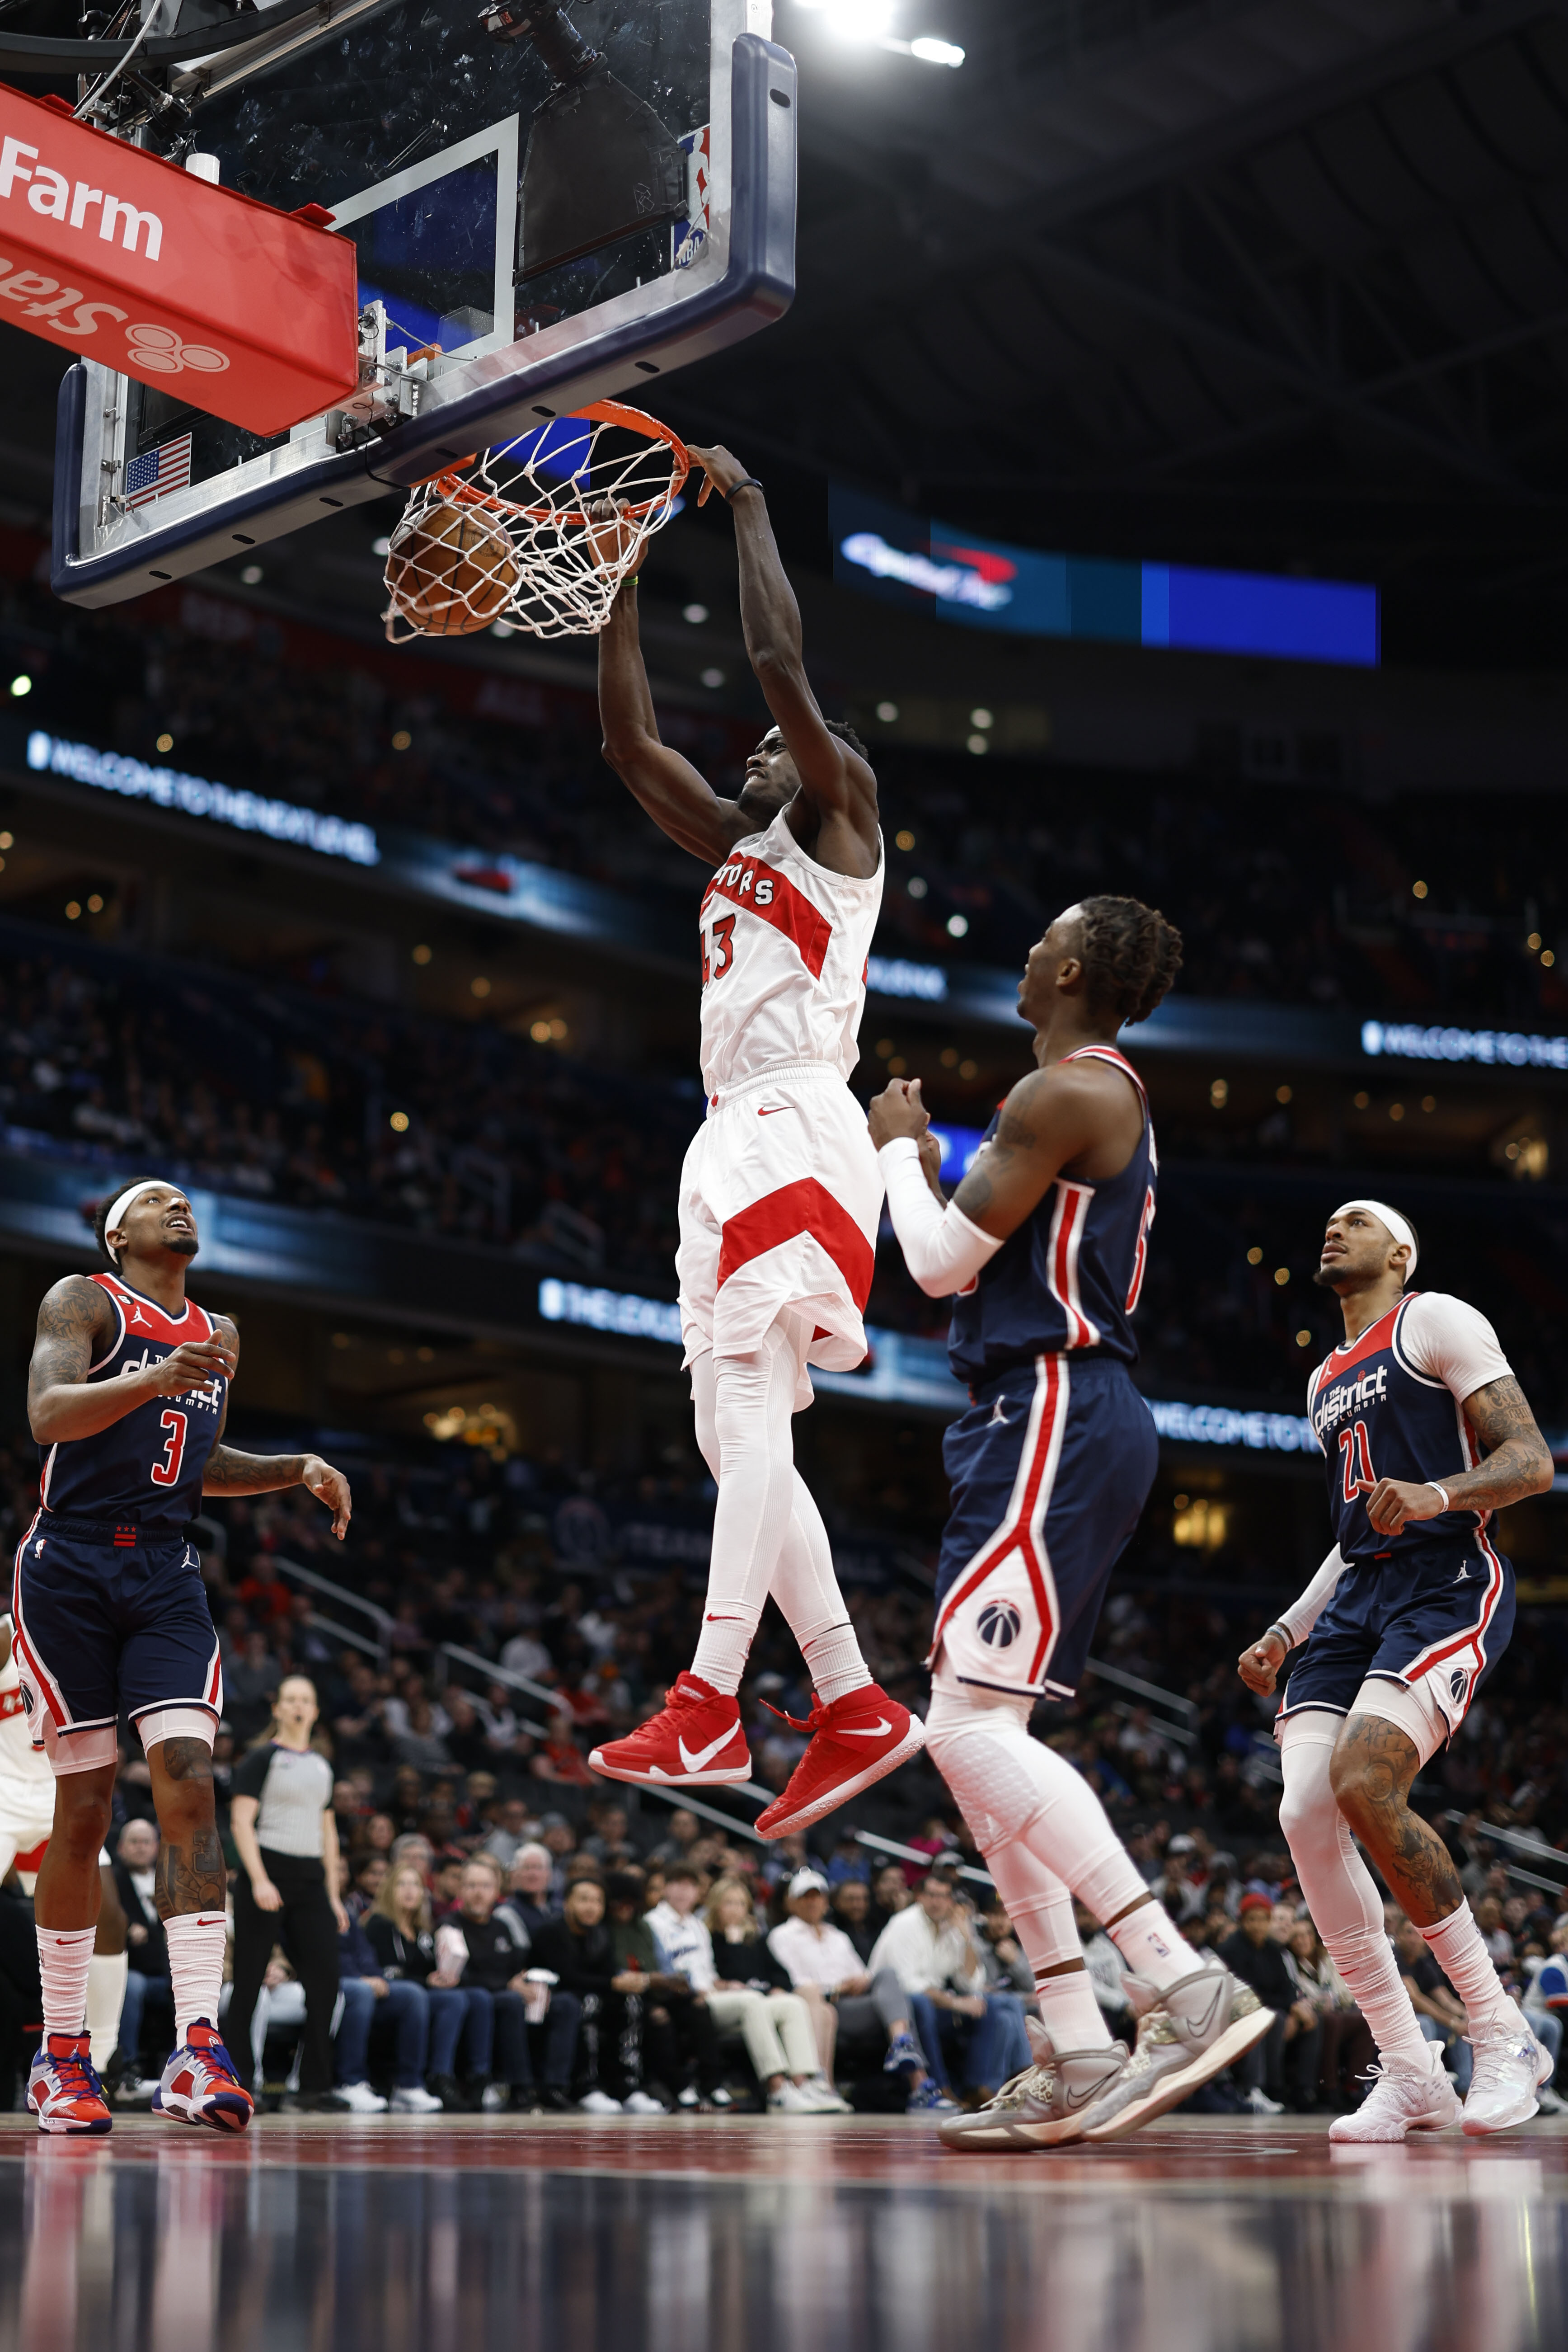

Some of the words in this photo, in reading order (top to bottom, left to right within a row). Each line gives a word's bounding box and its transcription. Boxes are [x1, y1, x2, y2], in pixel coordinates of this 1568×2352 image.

[0, 136, 163, 261] Farm
[0, 258, 128, 335] Sta
[702, 863, 774, 905] TORS
[1314, 1365, 1388, 1436] district
[1327, 1394, 1387, 1432] COLUMBIA
[1329, 1385, 1341, 1400] THE
[150, 1408, 188, 1487] 3
[1338, 1420, 1377, 1504] 21
